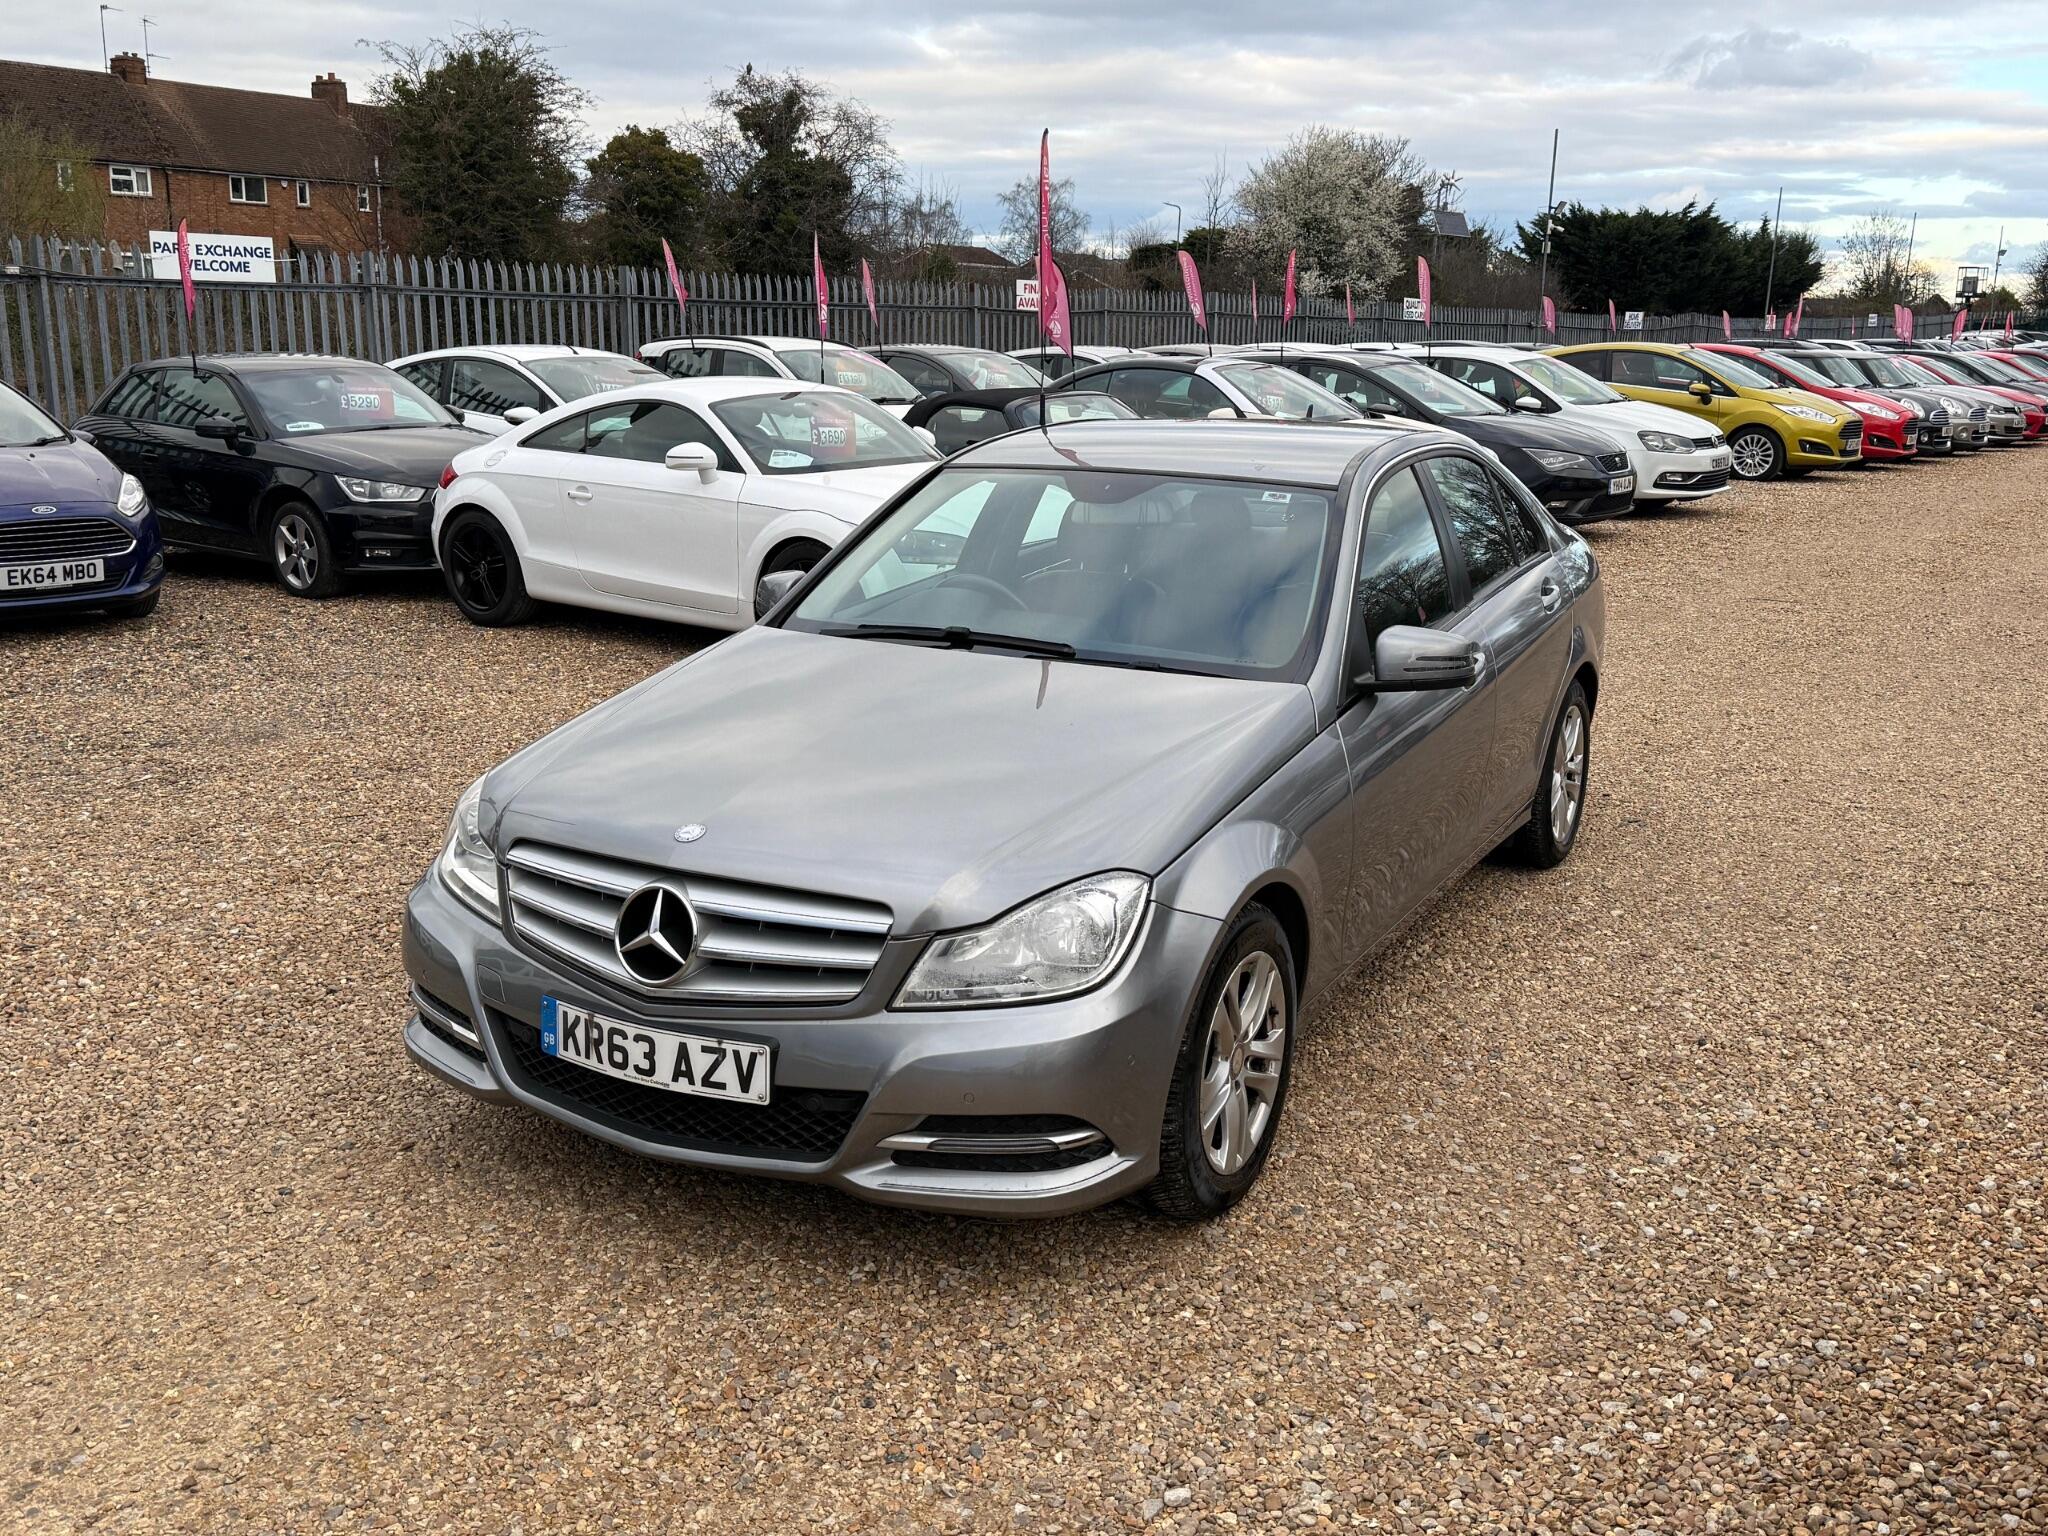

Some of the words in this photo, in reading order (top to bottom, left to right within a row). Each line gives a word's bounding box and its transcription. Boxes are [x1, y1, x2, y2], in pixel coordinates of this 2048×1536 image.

[195, 244, 271, 258] EXCHANGE
[341, 395, 380, 409] £5290
[812, 428, 846, 446] £3690
[7, 566, 57, 586] EK64
[62, 562, 97, 581] MBO
[544, 1032, 555, 1046] GB
[562, 1011, 656, 1077] KR63
[671, 1041, 758, 1094] AZV
